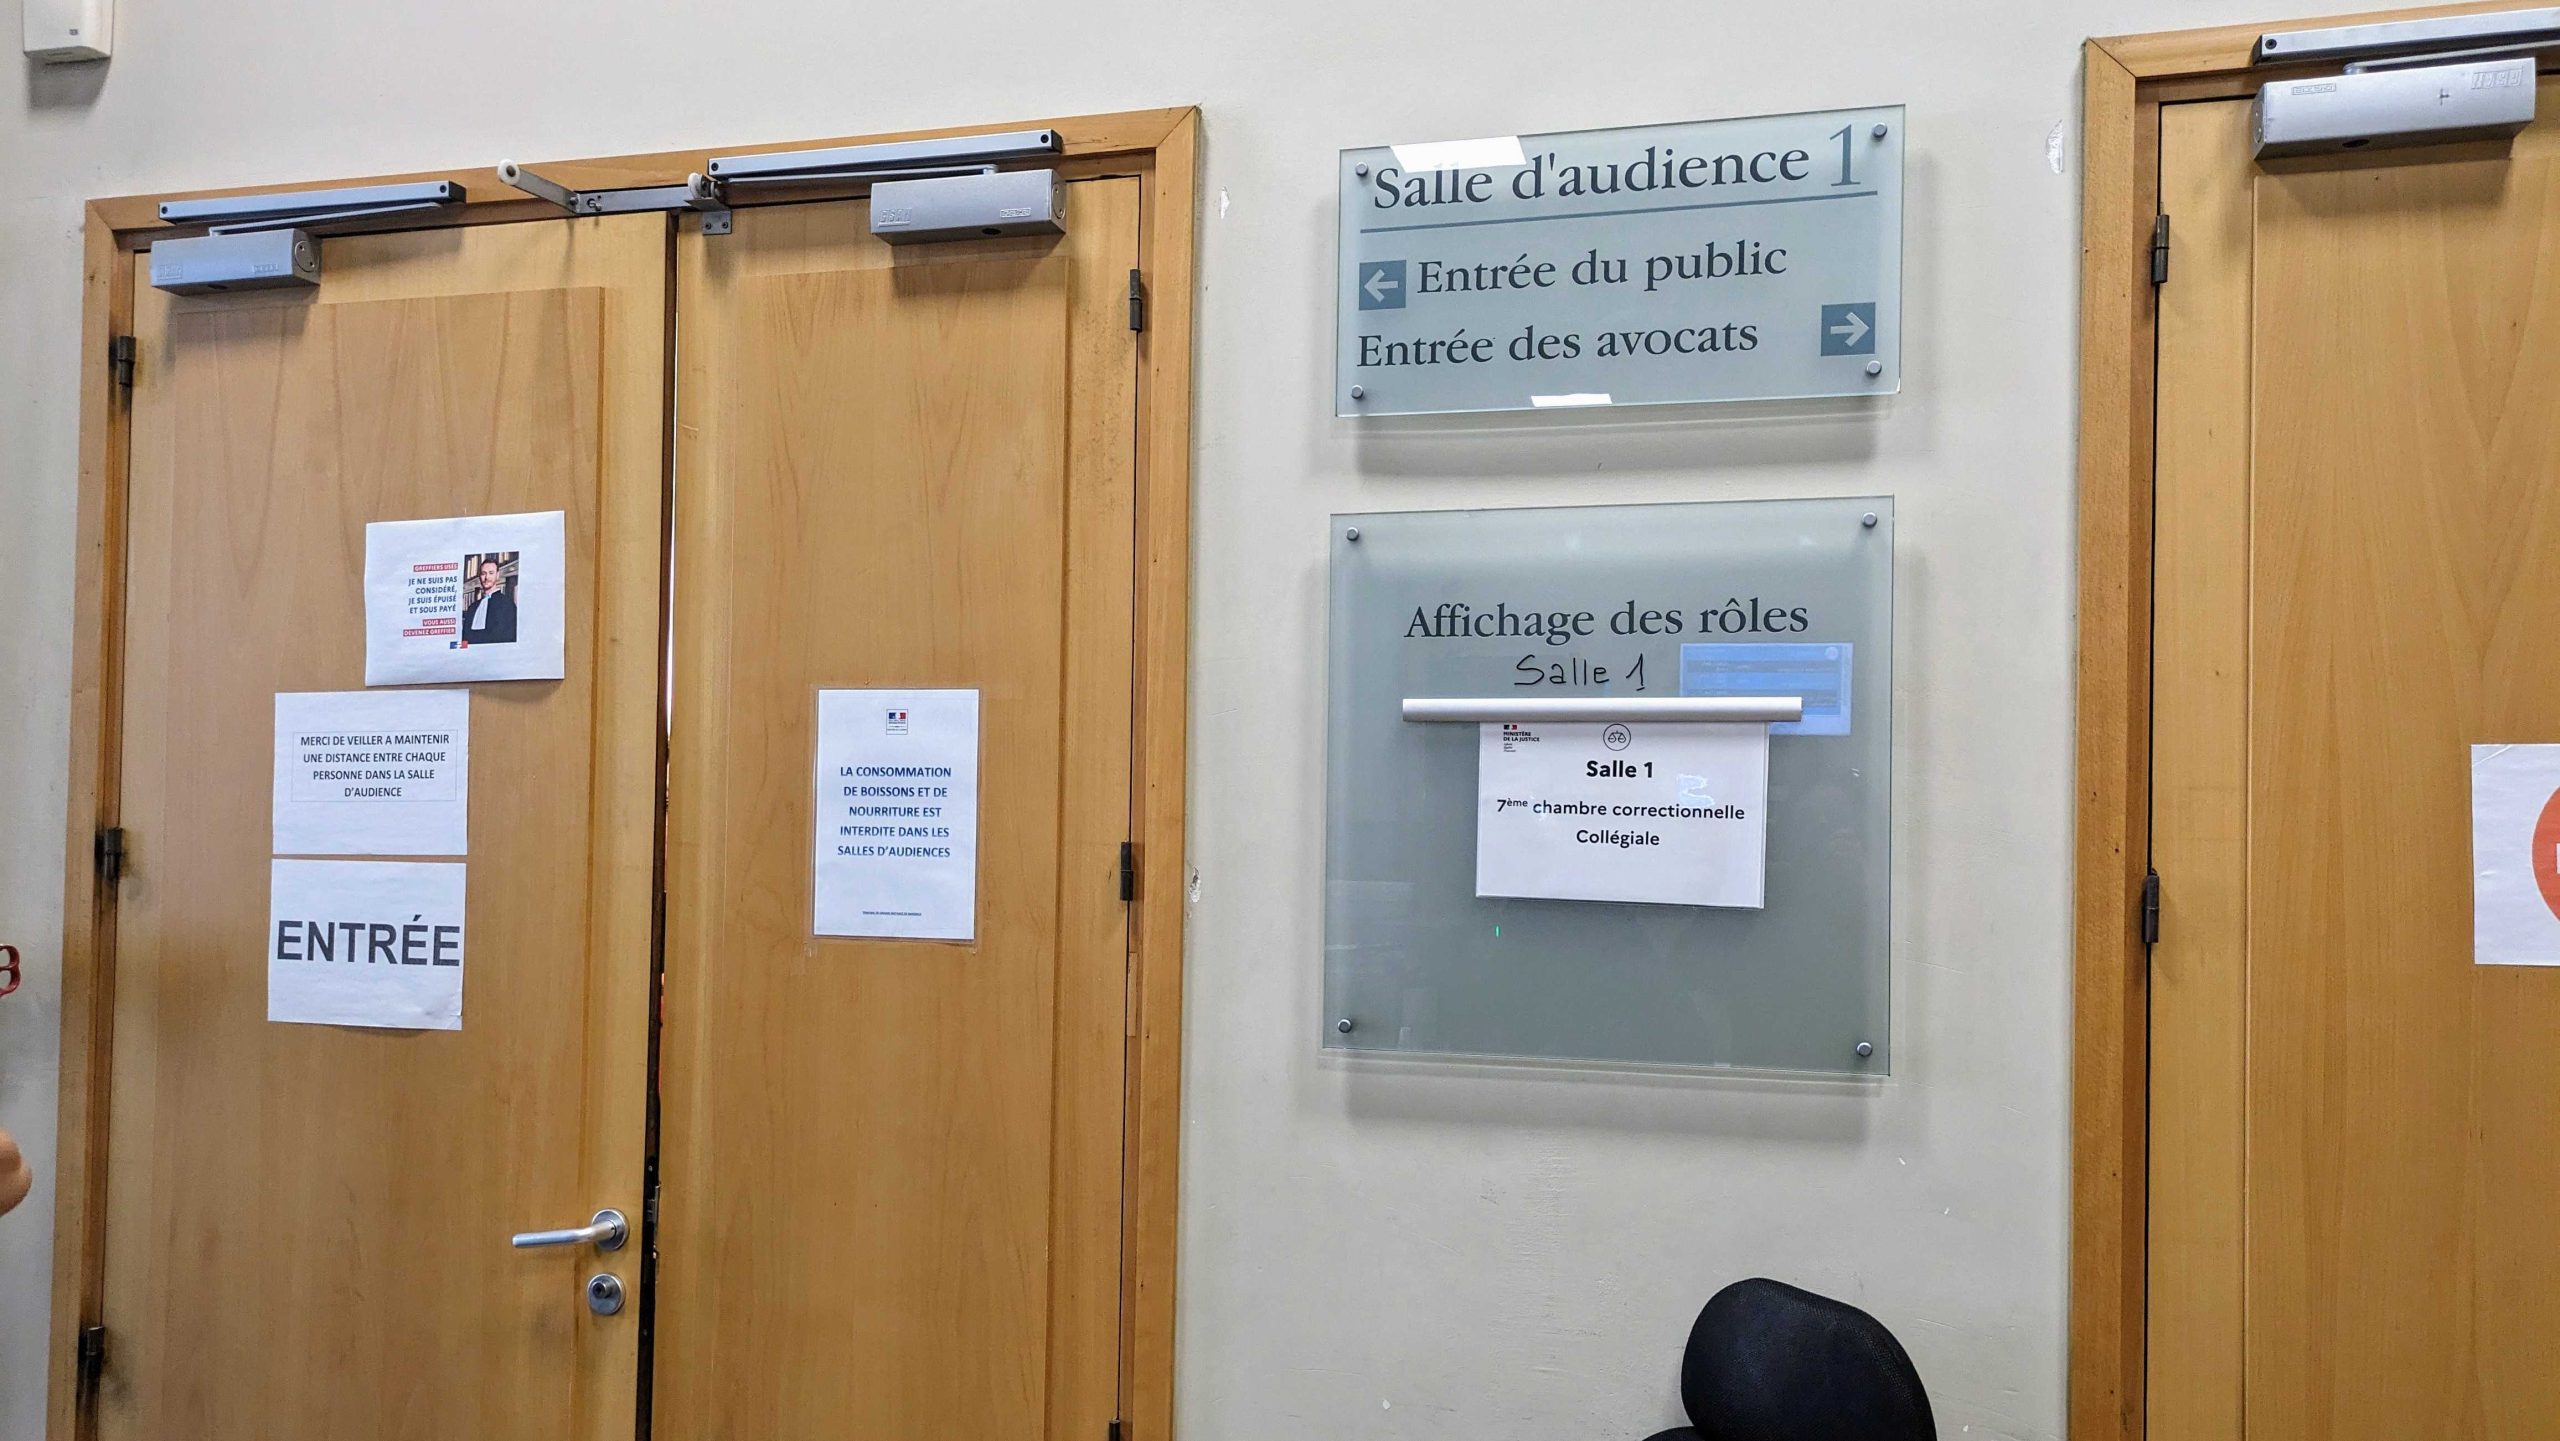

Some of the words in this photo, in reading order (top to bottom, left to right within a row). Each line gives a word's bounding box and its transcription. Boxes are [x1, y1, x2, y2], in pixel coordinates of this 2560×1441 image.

[1374, 163, 1493, 209] Salle
[1512, 145, 1810, 200] d'audience
[1829, 124, 1862, 188] 1
[1417, 253, 1556, 294] Entrée
[1572, 248, 1628, 285] du
[1644, 239, 1788, 293] public
[1357, 327, 1494, 368] Entrée
[1509, 324, 1581, 362] des
[1596, 319, 1759, 357] avocats
[408, 578, 415, 587] JE
[408, 597, 415, 606] JE
[439, 604, 456, 612] PAYÉ
[1403, 602, 1595, 646] Affichage
[1609, 600, 1683, 636] des
[1698, 597, 1809, 634] rôles
[1514, 654, 1610, 686] Salle
[1626, 653, 1645, 691] 1
[300, 736, 330, 746] MERCI
[333, 736, 345, 746] DE
[347, 735, 383, 745] VEILLER
[385, 735, 392, 744] A
[394, 734, 450, 745] MAINTENIR
[303, 753, 323, 763] UNE
[325, 753, 371, 763] DISTANCE
[373, 753, 403, 762] ENTRE
[405, 752, 446, 763] CHAQUE
[313, 770, 363, 780] PERSONNE
[365, 770, 391, 780] DANS
[394, 770, 405, 779] LA
[407, 769, 435, 779] SALLE
[840, 766, 853, 776] LA
[856, 766, 952, 777] CONSOMMATION
[1586, 760, 1637, 778] Salle
[1644, 761, 1653, 778] 1
[344, 787, 402, 797] D'AUDIENCE
[843, 786, 858, 796] DE
[861, 786, 915, 797] BOISSONS
[918, 787, 930, 797] ET
[933, 787, 948, 797] DE
[849, 806, 920, 817] NOURRITURE
[923, 807, 942, 817] EST
[1497, 798, 1529, 812] 7ème
[1533, 800, 1607, 815] chambre
[1612, 803, 1745, 819] correctionnelle
[840, 826, 895, 836] INTERDITE
[898, 827, 929, 837] DANS
[931, 827, 950, 837] LES
[1576, 829, 1660, 848] Collégiale
[837, 846, 875, 856] SALLES
[277, 915, 460, 967] ENTRÉE
